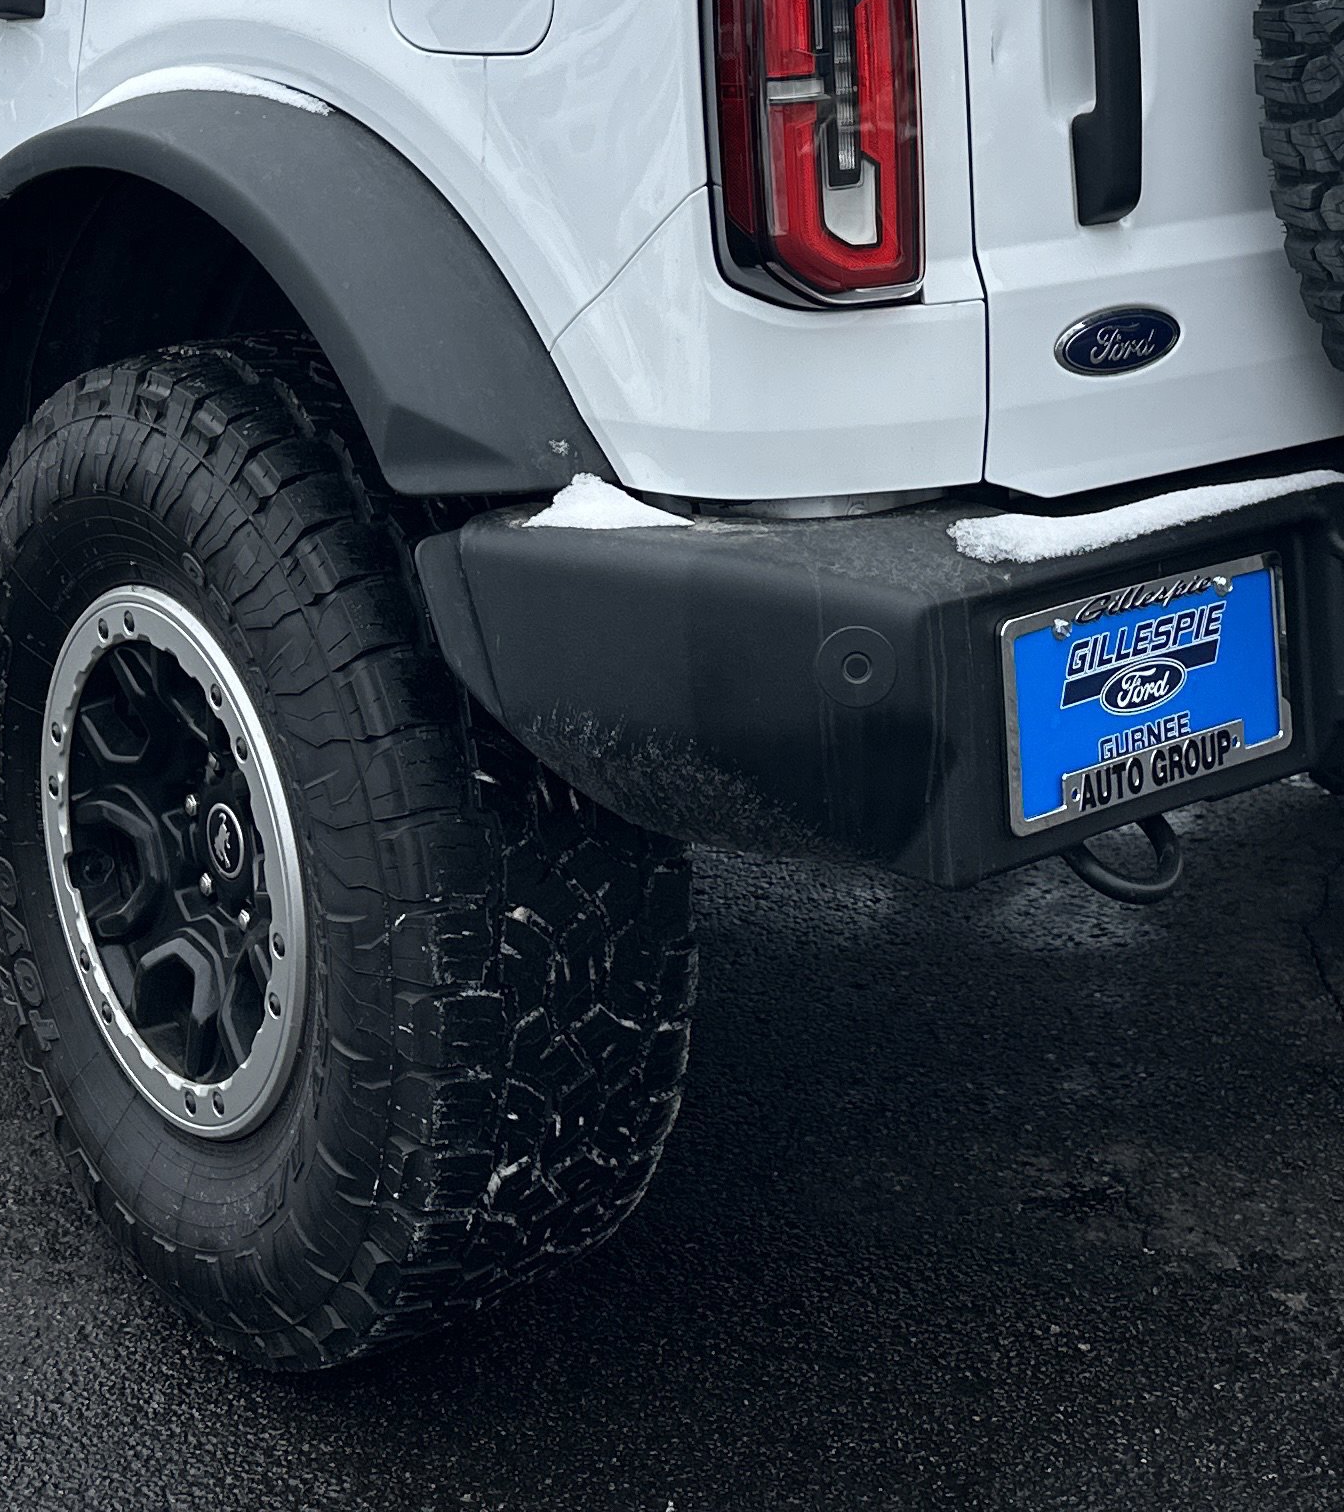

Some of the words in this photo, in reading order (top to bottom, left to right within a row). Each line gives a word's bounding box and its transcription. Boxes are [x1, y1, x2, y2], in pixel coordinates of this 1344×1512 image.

[1089, 321, 1156, 365] Ford
[1075, 574, 1213, 625] Gillespie
[1066, 600, 1227, 680] GILLESPIE
[1116, 667, 1171, 708] Ford
[1098, 710, 1191, 762] GURNEE
[1079, 756, 1145, 812] AUTO
[1150, 729, 1232, 787] GROUP
